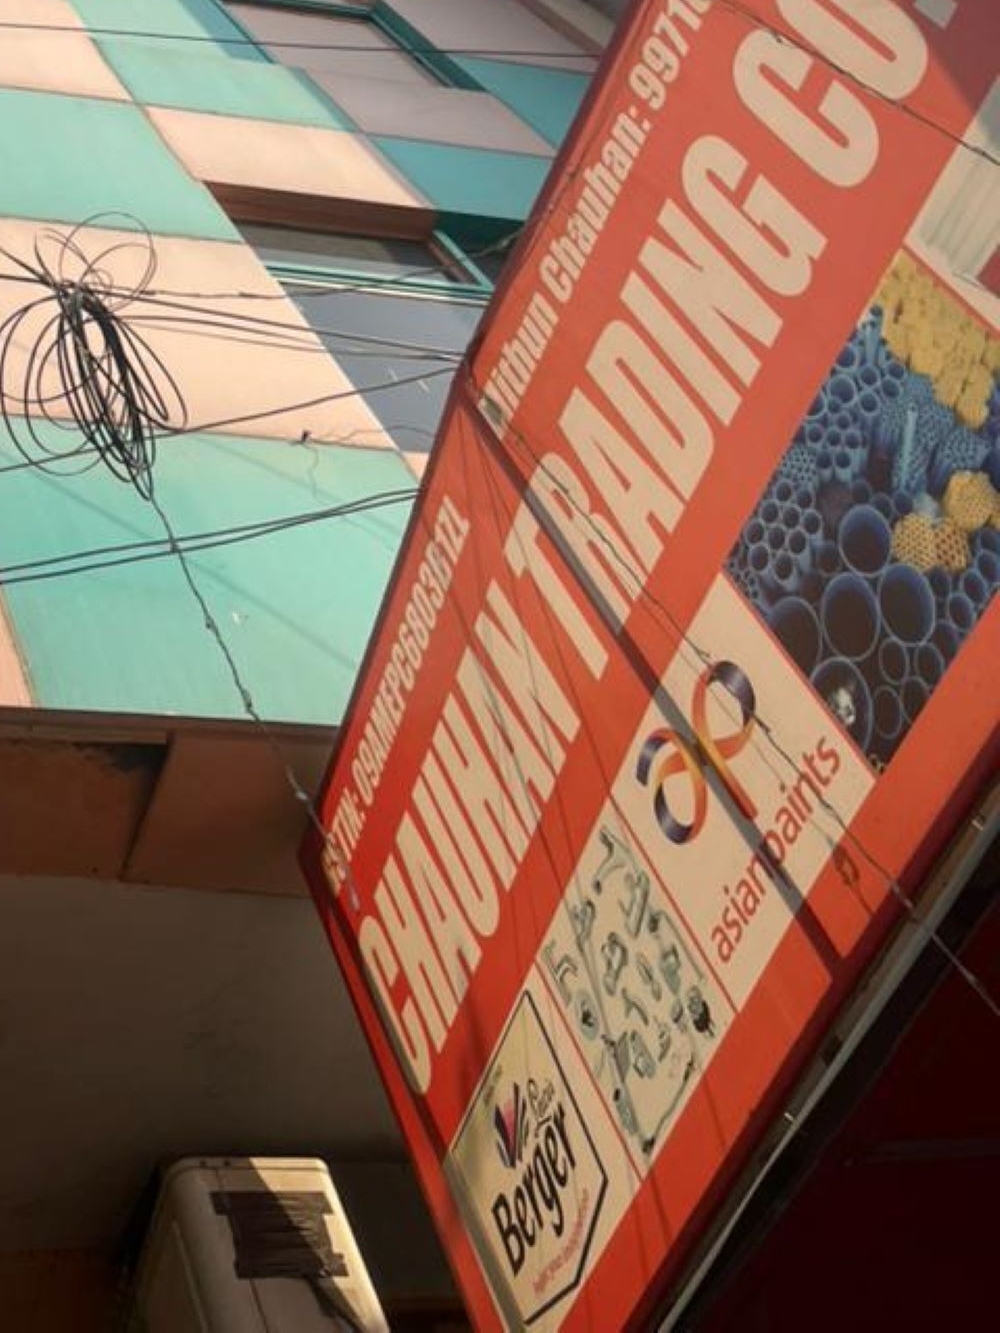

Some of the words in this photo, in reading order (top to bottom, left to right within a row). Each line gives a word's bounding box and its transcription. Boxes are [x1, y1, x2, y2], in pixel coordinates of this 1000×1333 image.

[539, 104, 651, 303] Chauhan:
[358, 578, 581, 1094] CHAUHAN
[504, 133, 828, 682] TRADING
[491, 1101, 577, 1277] Berger
